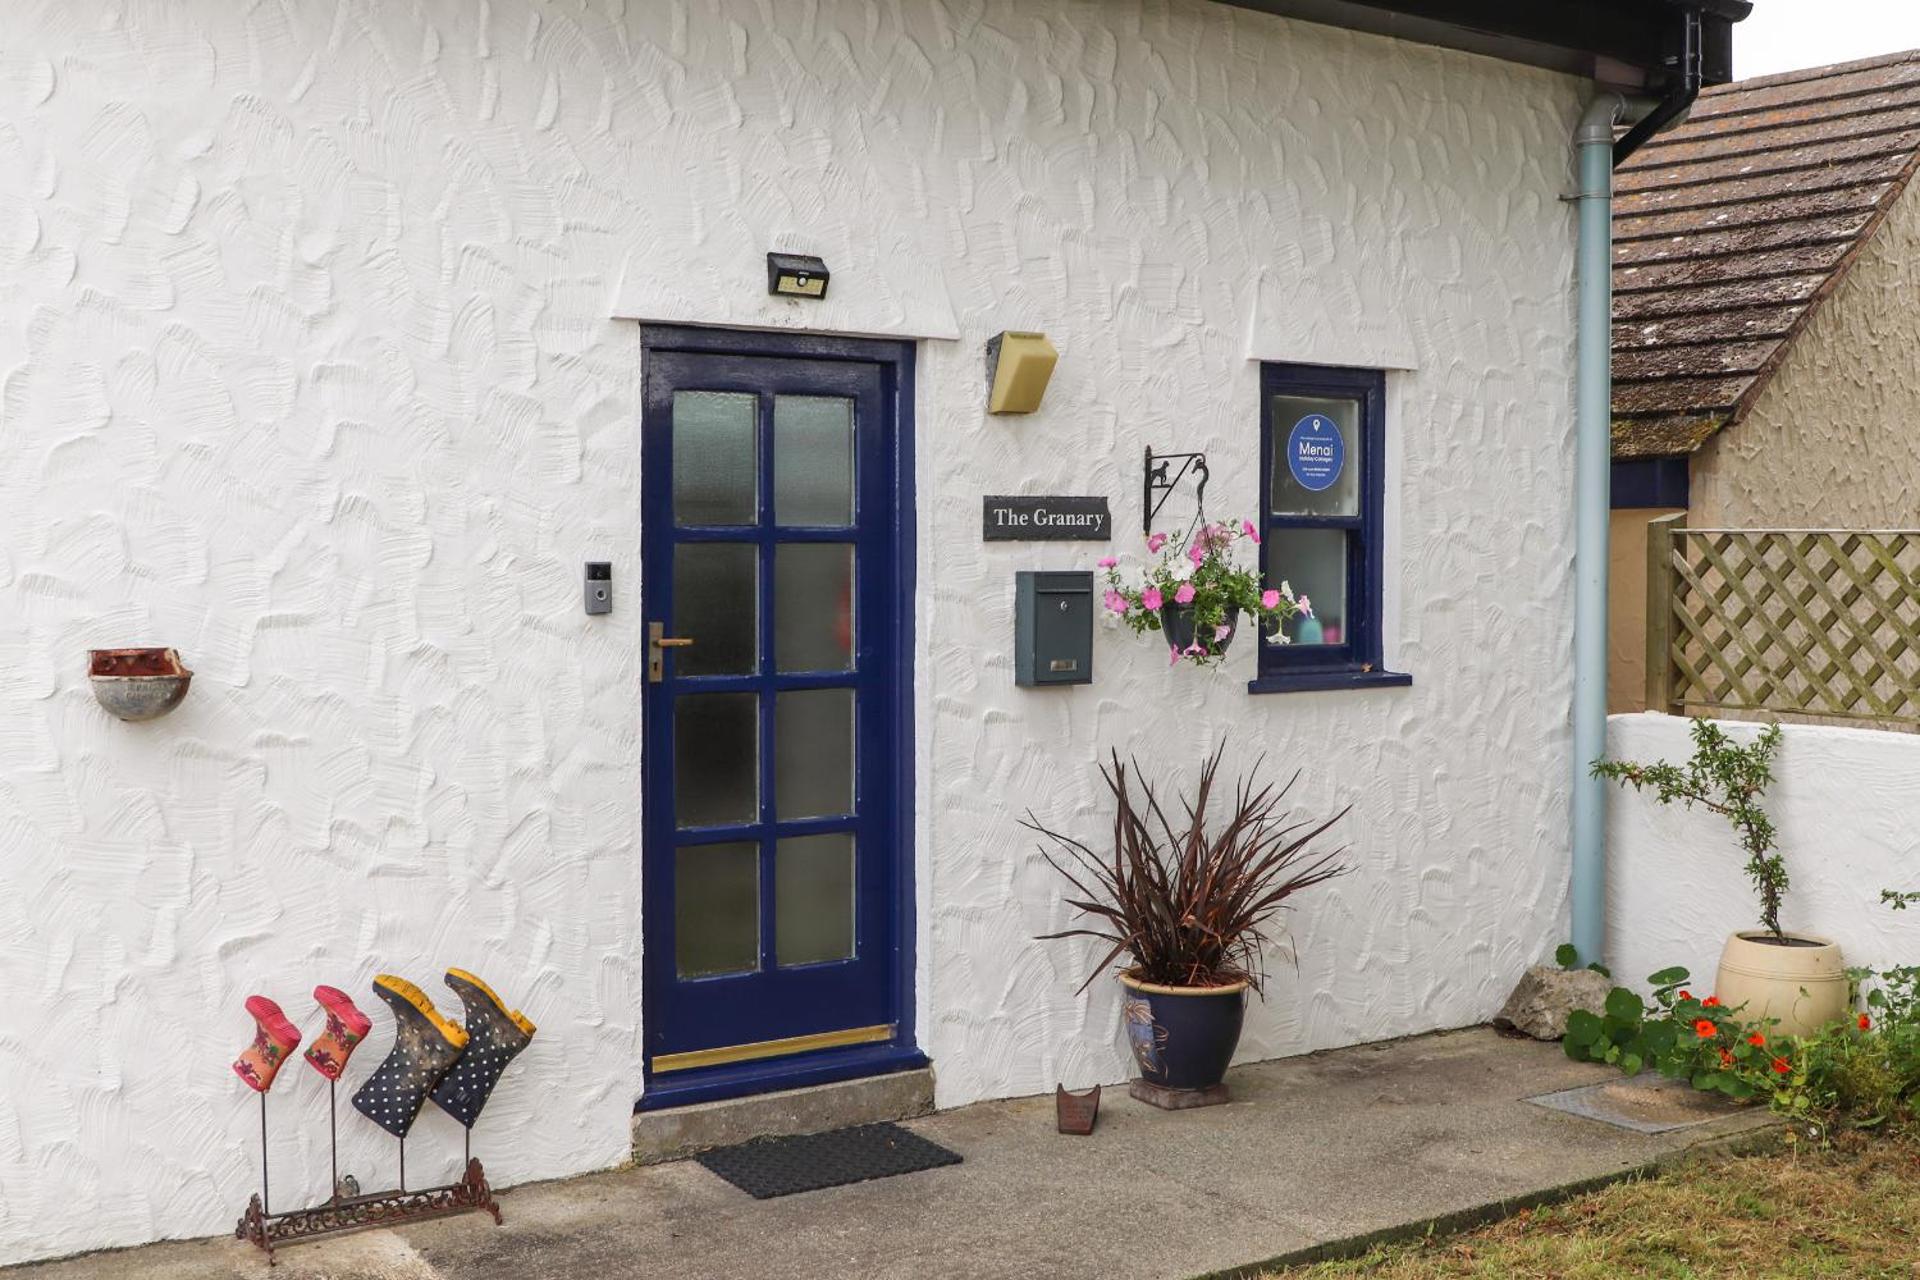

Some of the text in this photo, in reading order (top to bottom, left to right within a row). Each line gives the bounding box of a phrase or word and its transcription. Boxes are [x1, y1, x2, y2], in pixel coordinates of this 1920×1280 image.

[1299, 441, 1334, 456] Menai
[993, 508, 1105, 532] The Granary
